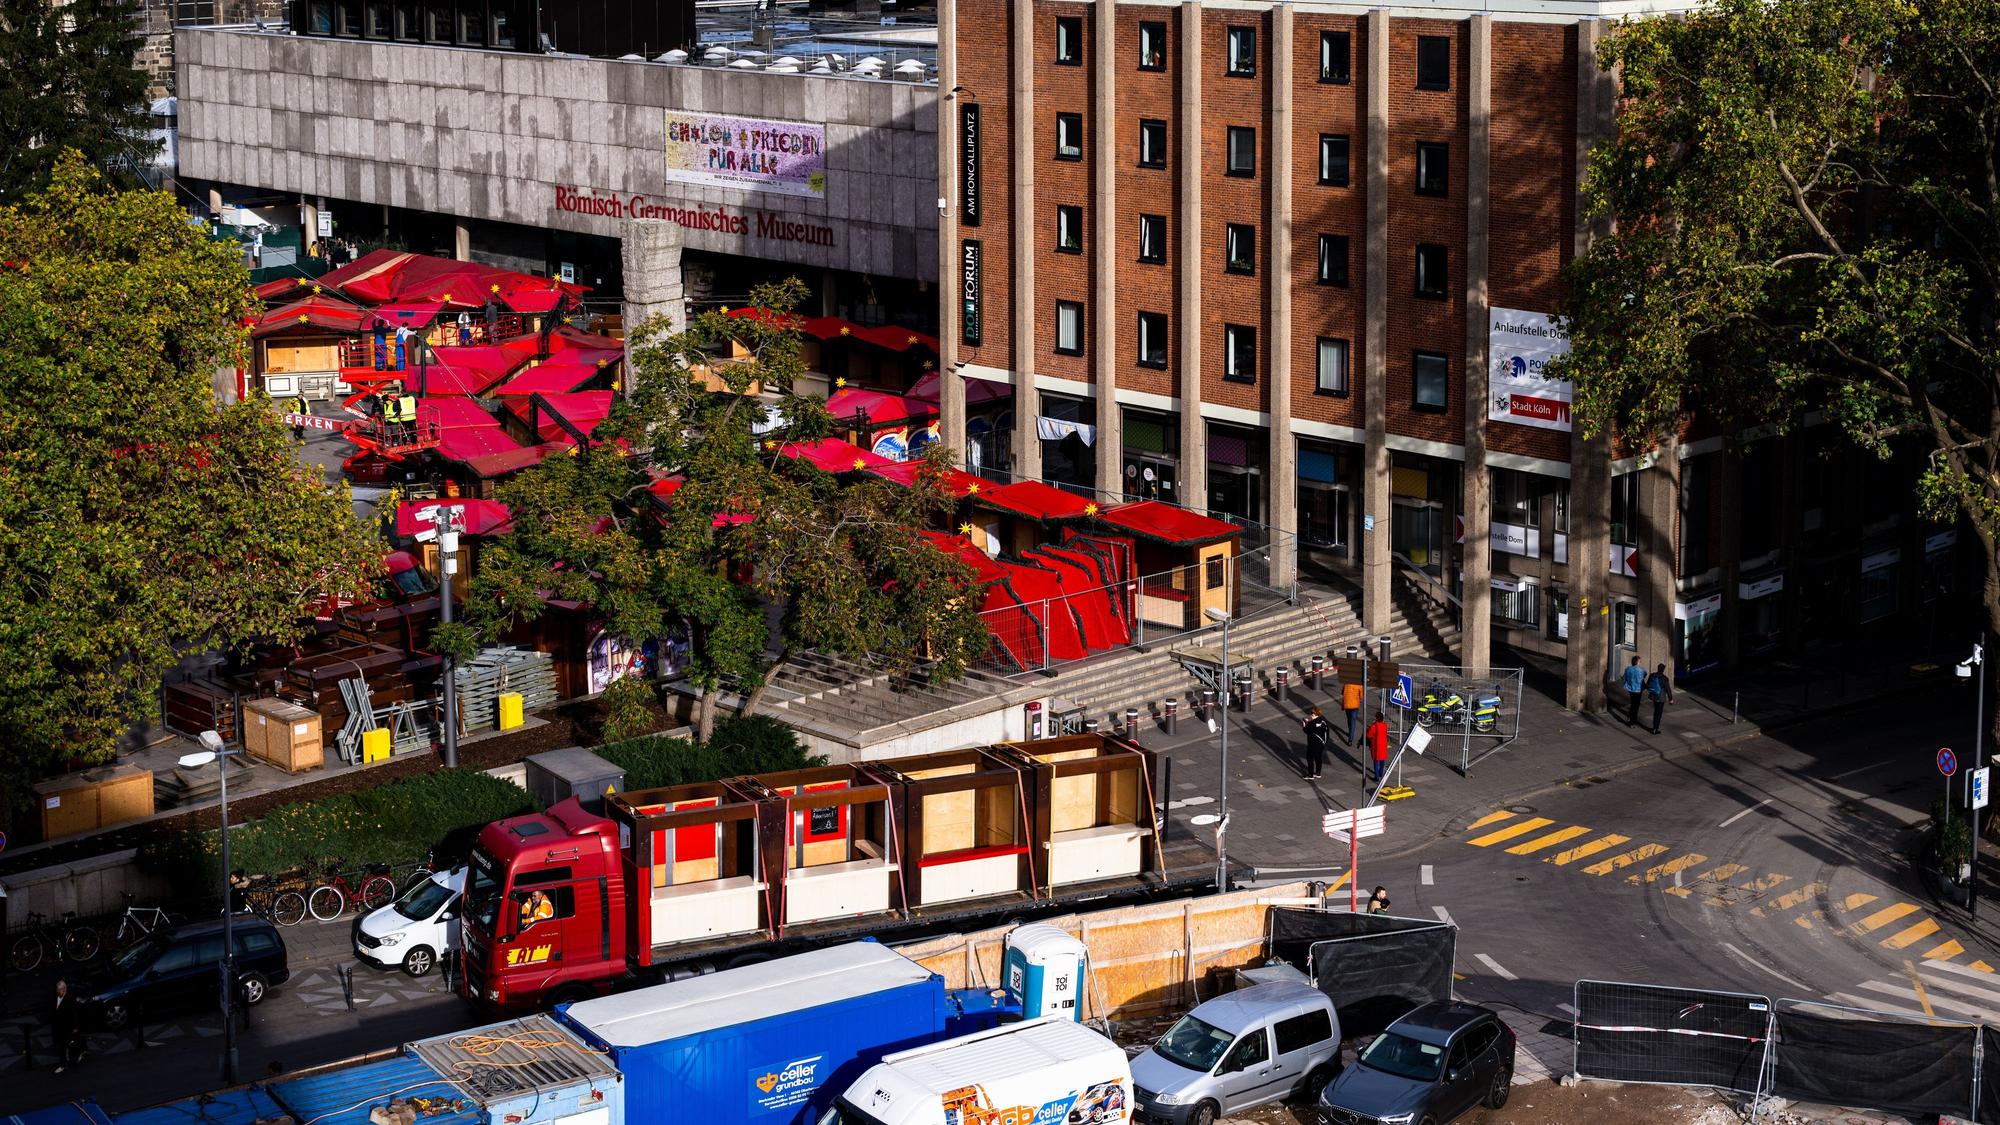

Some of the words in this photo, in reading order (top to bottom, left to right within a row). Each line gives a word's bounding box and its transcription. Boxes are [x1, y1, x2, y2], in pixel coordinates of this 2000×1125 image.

[751, 128, 820, 157] FRIEDEN
[709, 147, 737, 171] FÜR
[967, 112, 975, 195] RONCALLIPLATZ
[556, 184, 748, 236] Römisch-Germanisches
[756, 211, 834, 247] Museum
[967, 201, 975, 215] AM
[1494, 321, 1548, 338] Anlaufstelle
[1512, 400, 1532, 412] Stadt
[1533, 404, 1551, 415] Köln
[1509, 535, 1523, 544] Dom
[780, 1064, 817, 1082] celler
[776, 1076, 814, 1093] grundbau
[1038, 1102, 1069, 1120] celler
